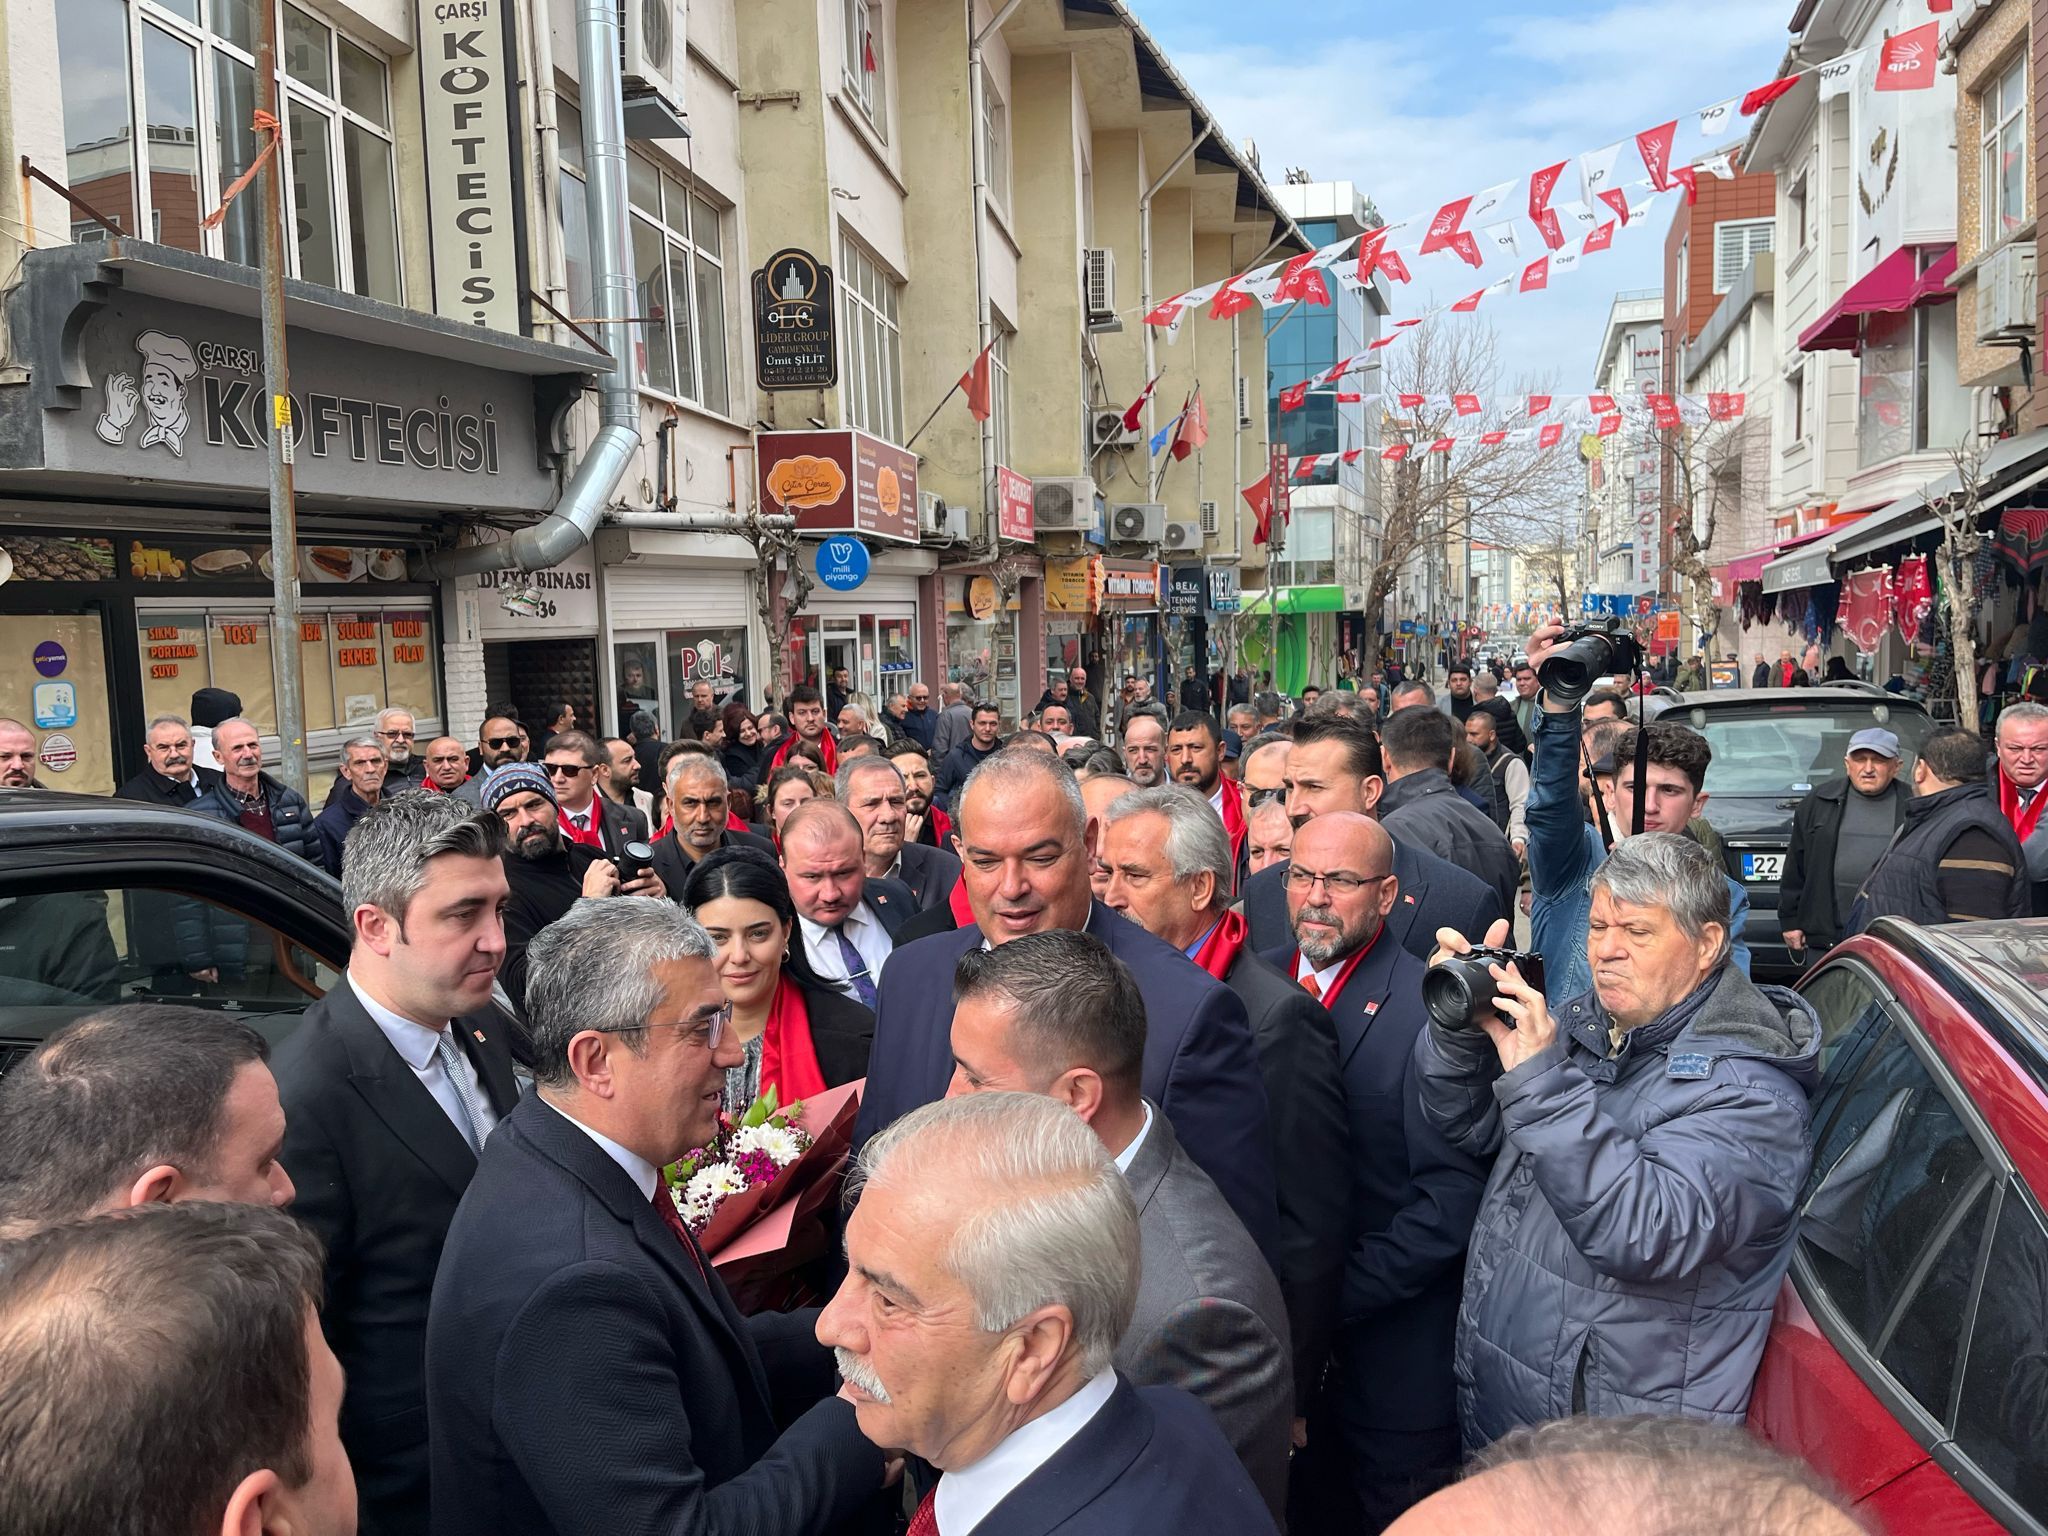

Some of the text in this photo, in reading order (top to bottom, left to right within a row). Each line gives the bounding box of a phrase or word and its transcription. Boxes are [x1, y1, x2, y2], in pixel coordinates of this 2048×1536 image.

[434, 1, 488, 24] ÇARŞI
[1556, 255, 1575, 264] CHP
[760, 331, 829, 344] LİDER GROUP
[199, 341, 258, 376] ÇARŞI
[766, 354, 792, 366] Ümit
[1639, 490, 1656, 584] HOTEL
[832, 564, 850, 573] milli
[535, 566, 591, 590] BİNASI
[825, 572, 859, 582] piyango
[1170, 595, 1197, 604] TEKNİK
[148, 626, 179, 640] SIKMA
[222, 624, 257, 645] TOST
[337, 621, 375, 640] SUCUK
[392, 620, 422, 638] KURU
[150, 644, 198, 659] PORTAKAL
[339, 647, 377, 667] EKMEK
[394, 643, 424, 663] PİLAV
[151, 664, 179, 679] SUYU
[1754, 857, 1778, 873] 22
